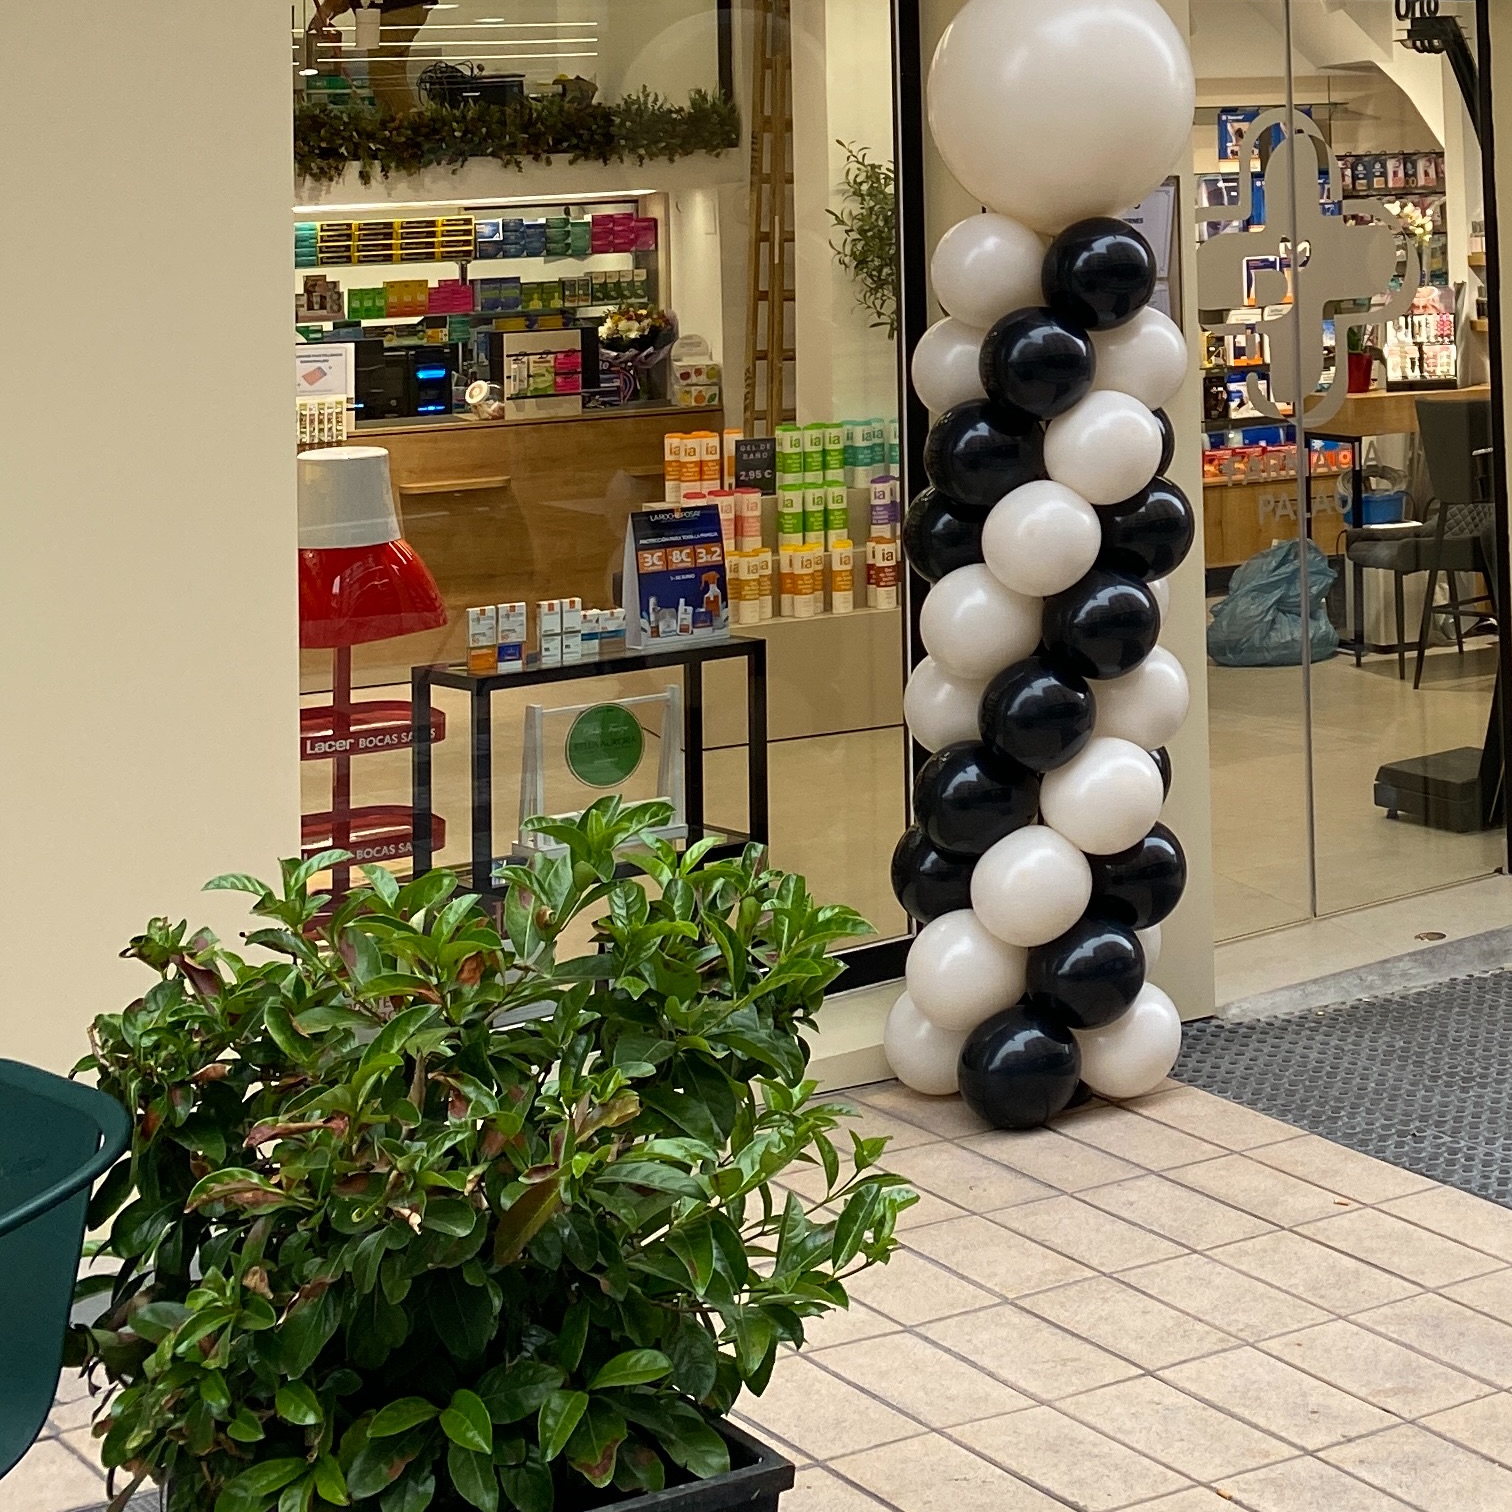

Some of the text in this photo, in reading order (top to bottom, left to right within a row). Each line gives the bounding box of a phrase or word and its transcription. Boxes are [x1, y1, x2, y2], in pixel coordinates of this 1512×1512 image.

[740, 470, 762, 481] 2,95
[882, 548, 893, 561] ia
[306, 728, 436, 754] Lacer BOCAS SAS
[356, 844, 395, 859] BOCAS
